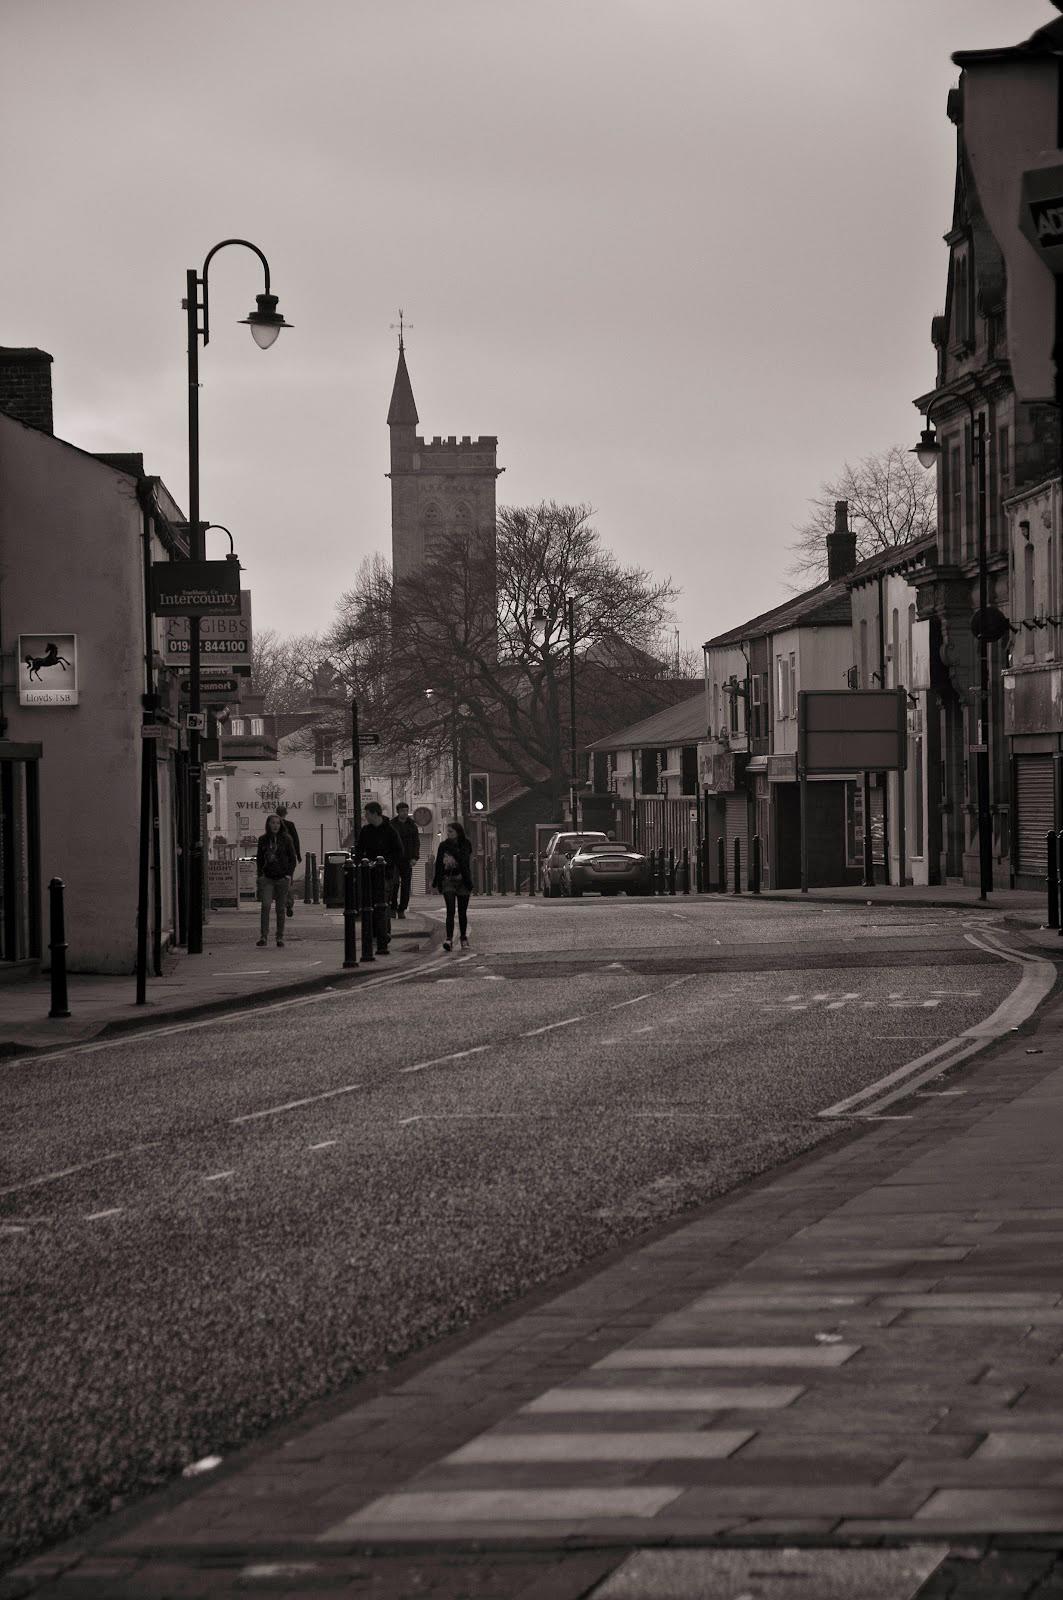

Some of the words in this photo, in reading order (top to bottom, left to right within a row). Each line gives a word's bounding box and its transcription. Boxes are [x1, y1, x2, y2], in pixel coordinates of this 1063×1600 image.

[159, 593, 238, 606] Intercounty
[199, 619, 248, 633] GIBBS
[204, 641, 245, 652] 844100
[26, 693, 53, 704] Lloyds
[260, 791, 279, 800] THE
[236, 800, 304, 810] WHEATSHEAF
